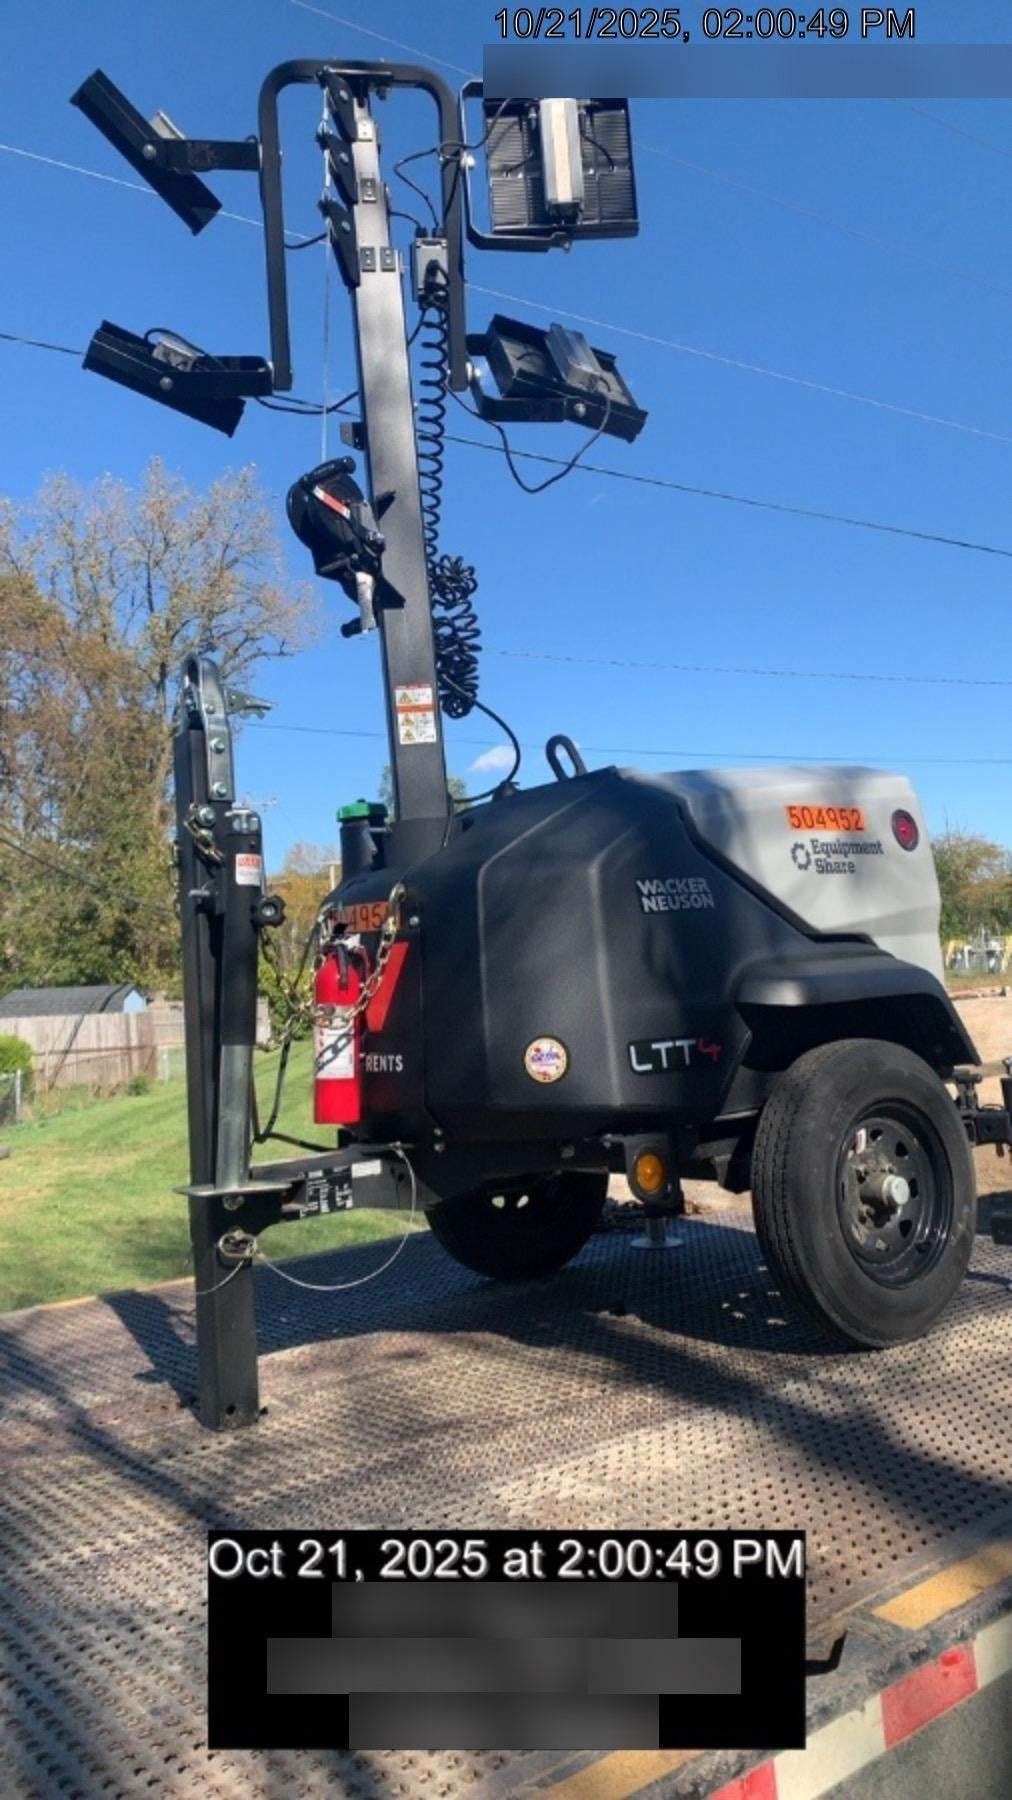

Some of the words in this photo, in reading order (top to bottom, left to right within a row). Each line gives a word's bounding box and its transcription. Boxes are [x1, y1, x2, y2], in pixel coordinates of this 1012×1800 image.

[787, 805, 864, 831] 504952
[810, 838, 884, 858] Equipment
[814, 858, 856, 874] Share
[636, 878, 711, 895] WACKER
[641, 893, 715, 912] NEUSON
[630, 1038, 722, 1072] LTT4
